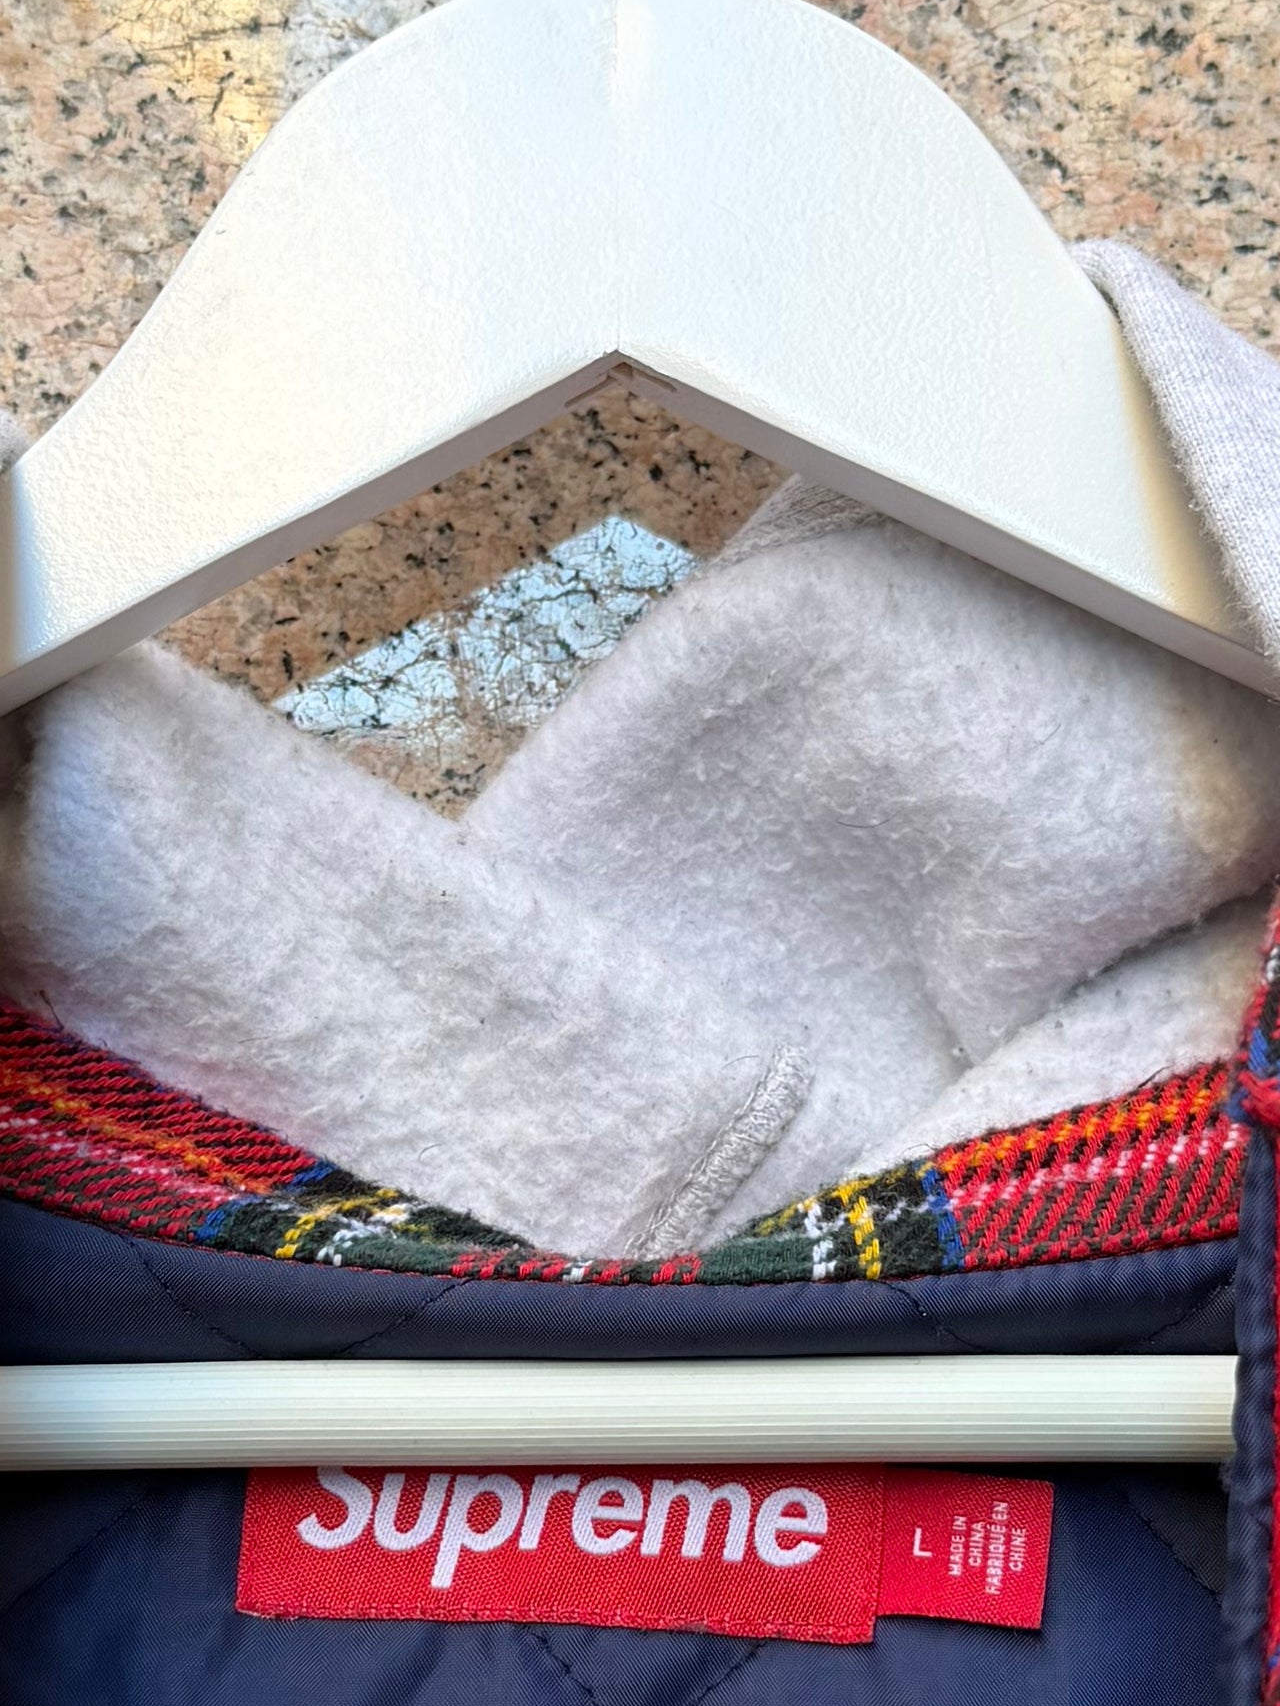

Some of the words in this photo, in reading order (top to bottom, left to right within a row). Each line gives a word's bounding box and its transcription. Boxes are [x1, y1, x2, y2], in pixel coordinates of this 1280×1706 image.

[296, 1466, 829, 1590] Supreme
[952, 1515, 967, 1531] IN
[991, 1500, 1009, 1522] EN
[913, 1527, 933, 1557] L
[948, 1534, 966, 1576] MADE
[968, 1521, 986, 1567] CHINA
[1008, 1528, 1027, 1572] CHINE
